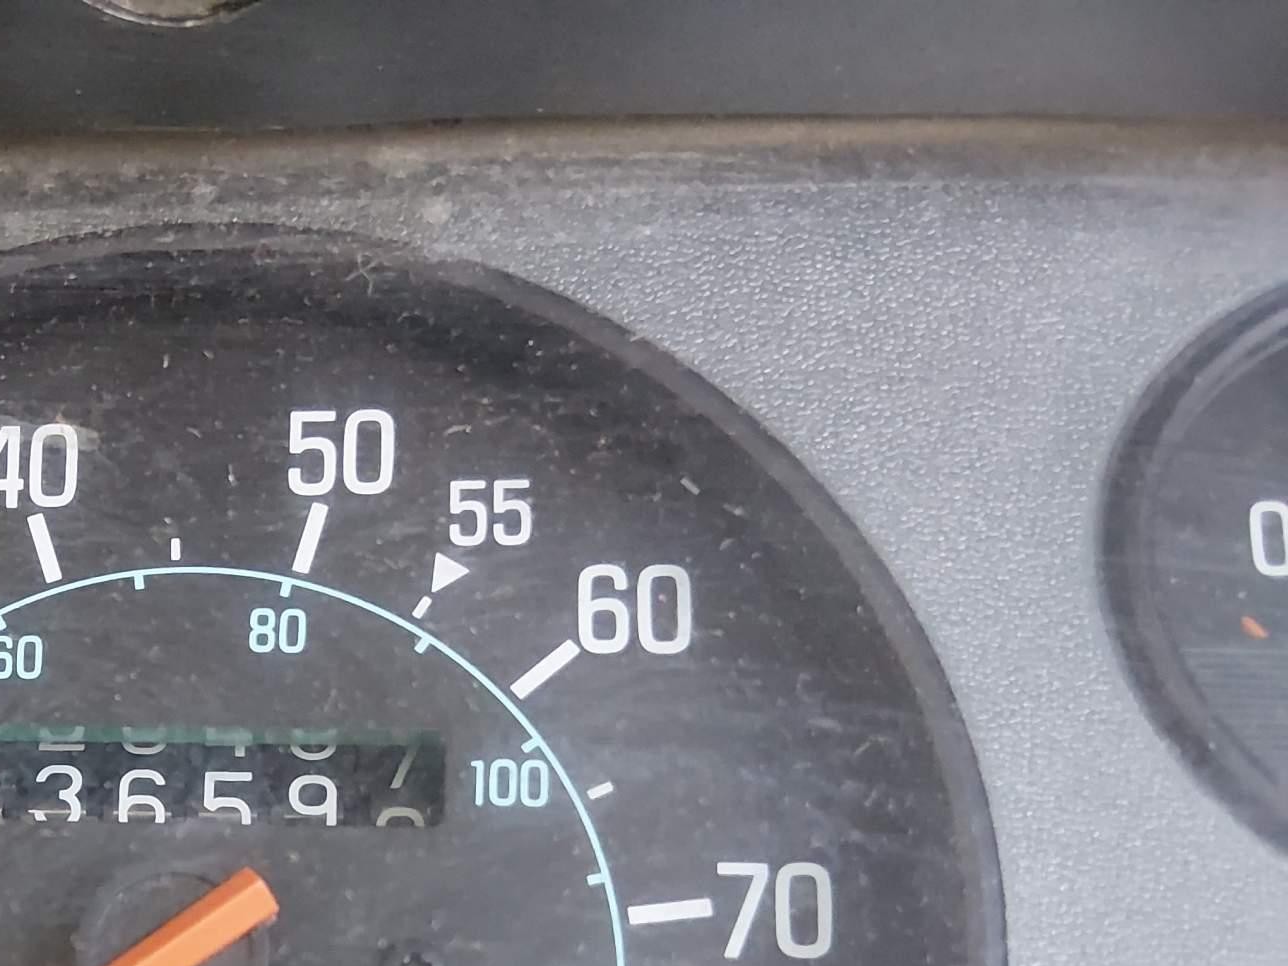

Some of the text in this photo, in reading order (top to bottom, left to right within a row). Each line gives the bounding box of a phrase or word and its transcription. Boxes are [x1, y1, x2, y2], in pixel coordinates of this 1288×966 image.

[287, 408, 395, 496] 50
[448, 479, 533, 547] 55
[248, 607, 307, 655] 80
[577, 563, 693, 655] 60
[470, 758, 550, 808] 100
[716, 862, 833, 960] 70
